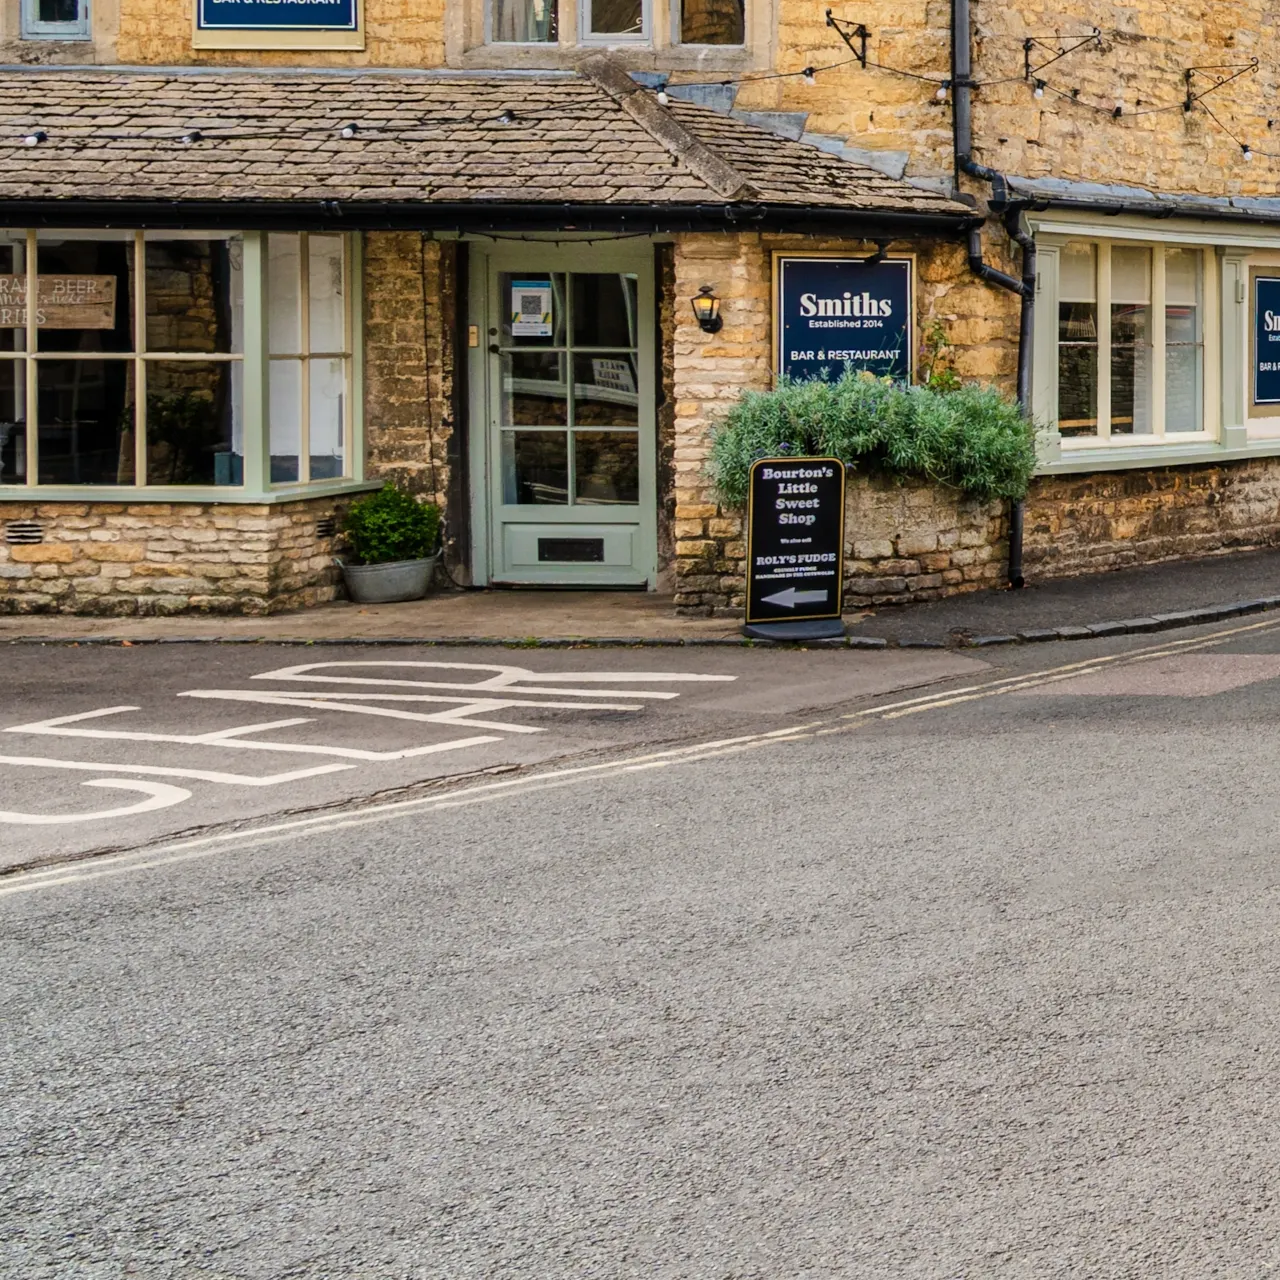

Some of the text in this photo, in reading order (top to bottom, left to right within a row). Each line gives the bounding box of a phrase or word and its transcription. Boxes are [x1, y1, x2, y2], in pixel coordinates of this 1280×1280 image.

[0, 278, 97, 294] RAT BEER
[799, 291, 892, 317] Smiths
[809, 320, 883, 328] Established 2014
[790, 349, 901, 361] BAR & RESTAURANT
[1260, 362, 1272, 371] BAR
[1272, 362, 1277, 371] &
[762, 467, 834, 480] Bourton's
[778, 482, 818, 495] Little
[775, 498, 820, 509] Sweet
[778, 513, 816, 526] Shop
[756, 552, 836, 566] ROLY'S FUDGE
